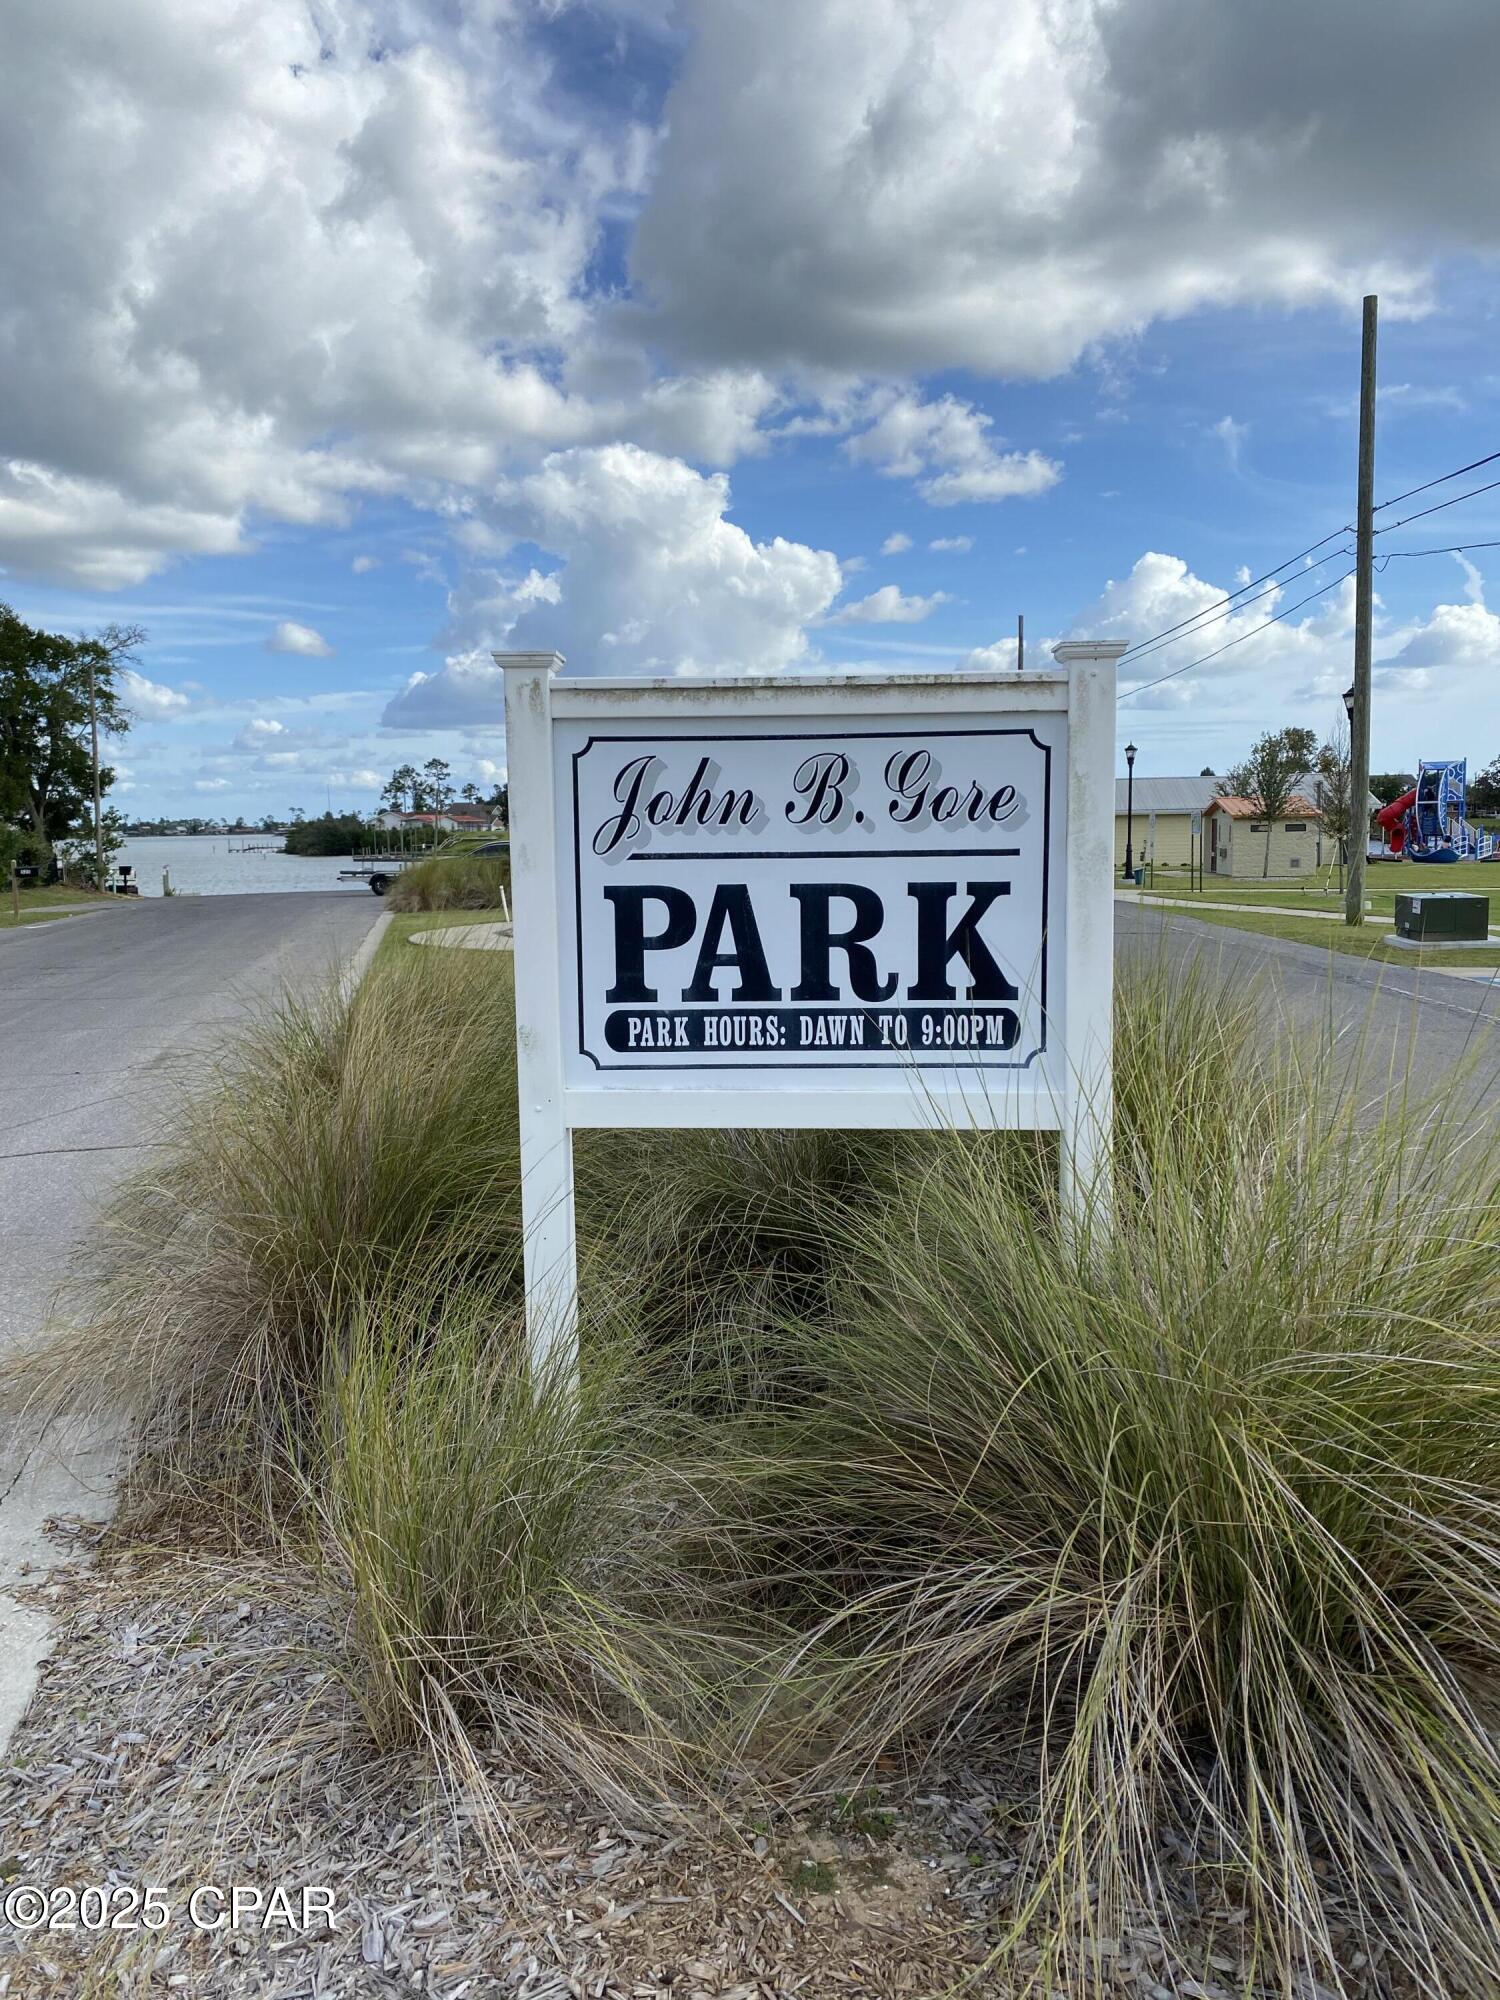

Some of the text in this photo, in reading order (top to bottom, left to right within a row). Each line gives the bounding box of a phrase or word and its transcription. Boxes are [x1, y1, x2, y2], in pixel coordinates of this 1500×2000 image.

[593, 749, 1019, 856] John B. Gore
[603, 881, 1019, 1003] PARK
[628, 1014, 1004, 1047] PARK HOURS: DAWN TO 9:00PM
